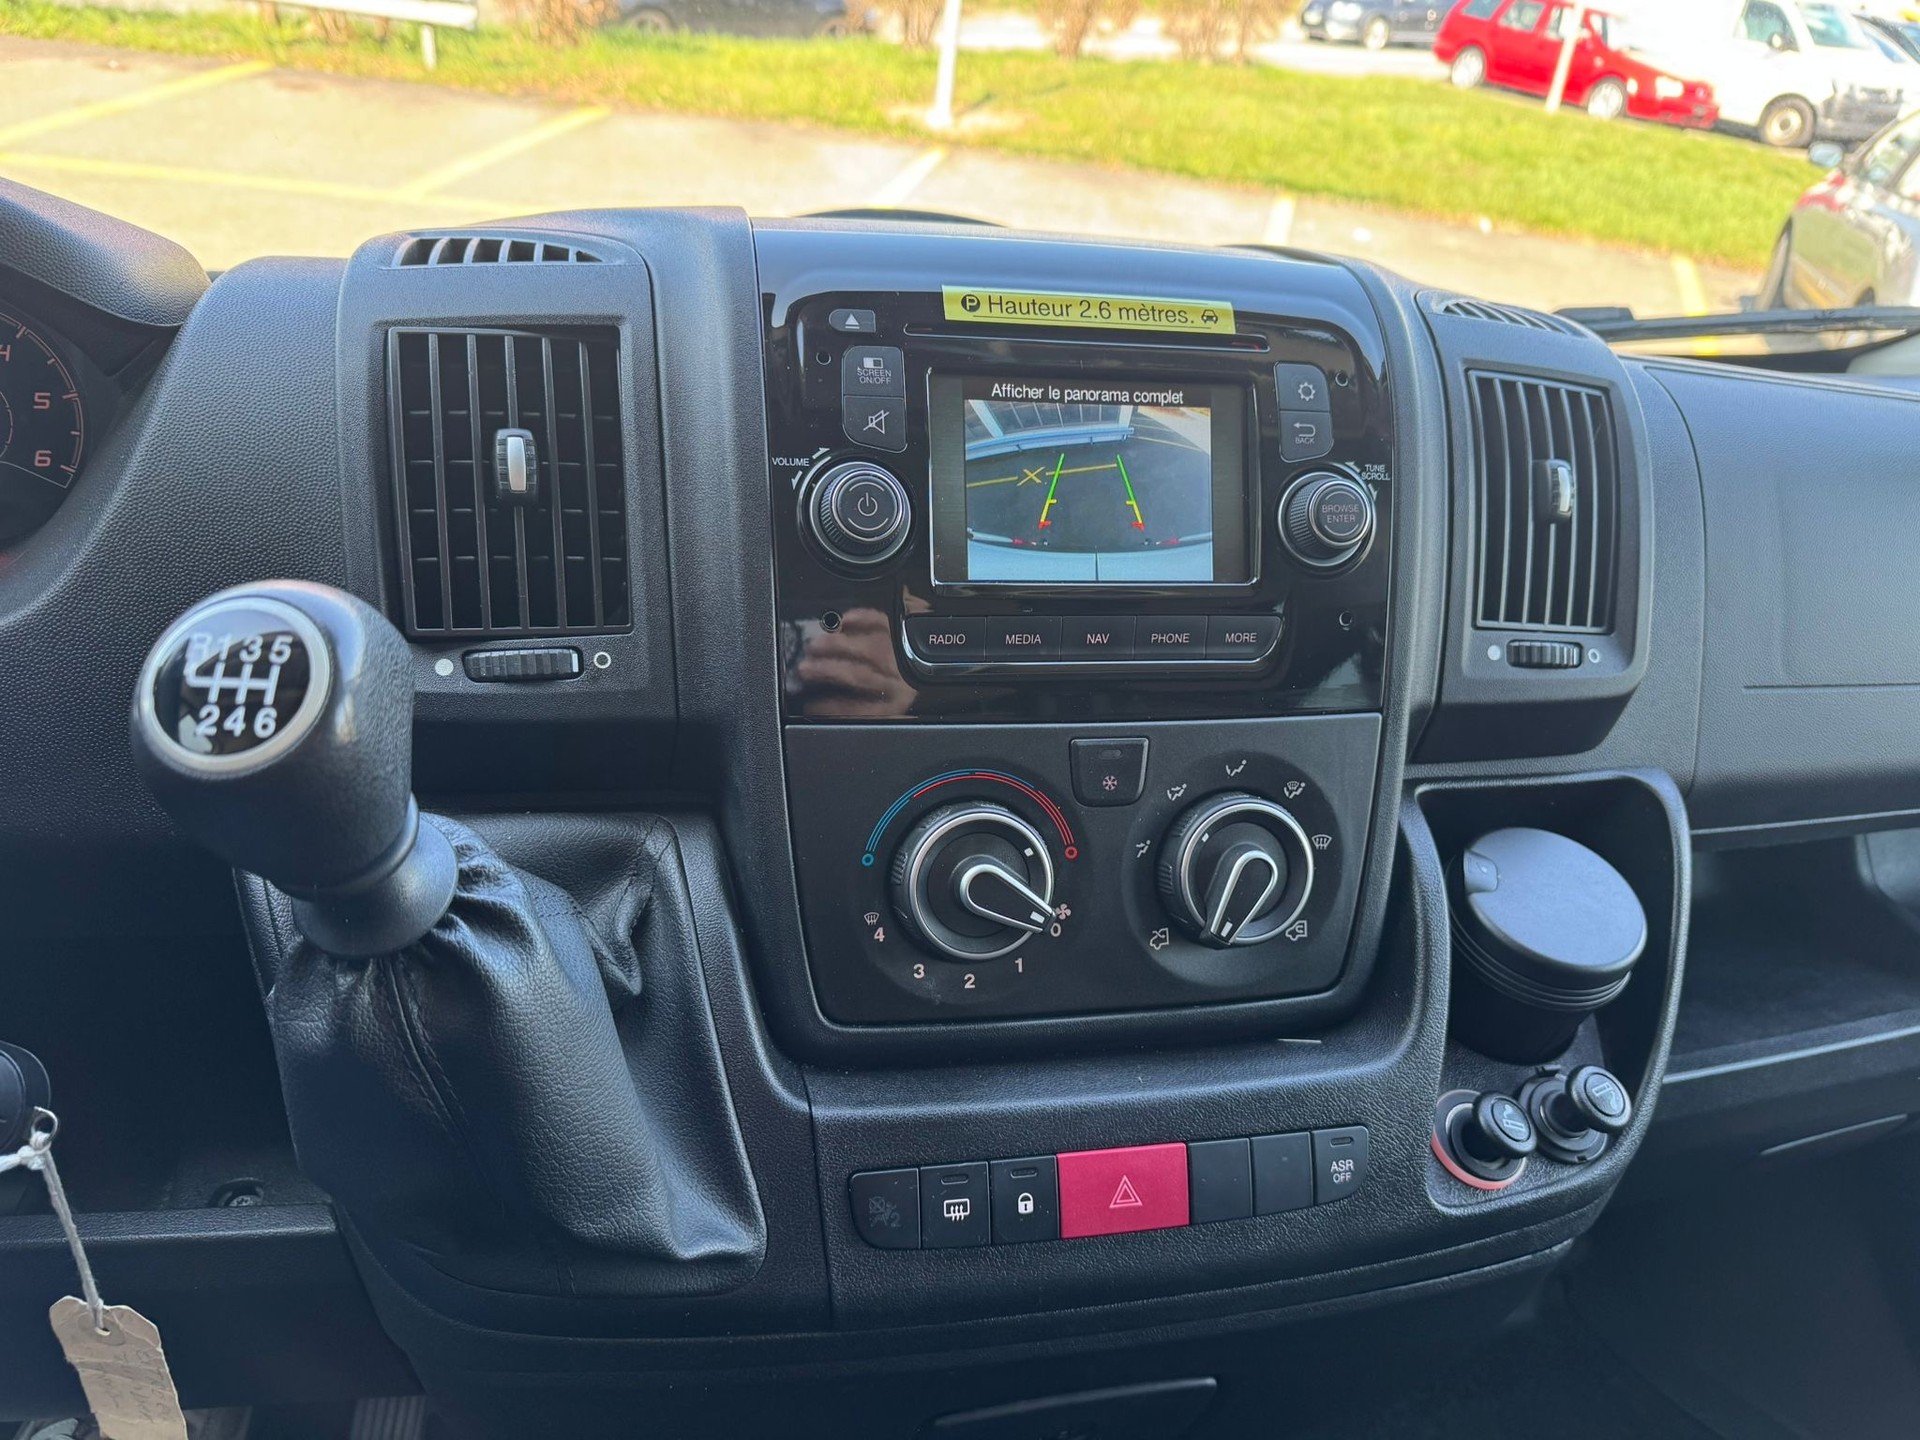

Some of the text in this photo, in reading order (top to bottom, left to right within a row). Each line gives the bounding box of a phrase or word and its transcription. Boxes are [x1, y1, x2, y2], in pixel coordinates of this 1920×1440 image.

[988, 295, 1072, 317] Hauteur
[1079, 300, 1111, 320] 2.6
[1118, 302, 1194, 324] mètres.
[857, 368, 891, 377] SCREEN
[859, 376, 891, 385] ON/OFF
[991, 384, 1184, 405] Afficher le panorama complet
[33, 392, 51, 410] 5
[1295, 437, 1315, 445] BACK
[34, 450, 52, 467] 6
[772, 457, 810, 467] VOLUME
[1365, 464, 1386, 473] TUNE
[1361, 472, 1391, 481] SCROLL
[1321, 504, 1359, 513] BROWSE
[1326, 514, 1356, 523] ENTER
[928, 633, 967, 645] RADIO
[1004, 633, 1042, 645] MEDIA
[1086, 633, 1110, 645] NAV
[1150, 632, 1190, 644] PHONE
[1224, 632, 1257, 644] MORE
[216, 633, 232, 661] 1
[239, 635, 263, 662] 3
[268, 634, 294, 665] 5
[195, 703, 278, 739] 2 4 6
[873, 926, 885, 943] 4
[1049, 923, 1062, 937] 0
[913, 963, 925, 979] 3
[1014, 957, 1024, 973] 1
[964, 973, 976, 989] 2
[1330, 1159, 1354, 1172] ASR
[1332, 1172, 1351, 1184] OFF
